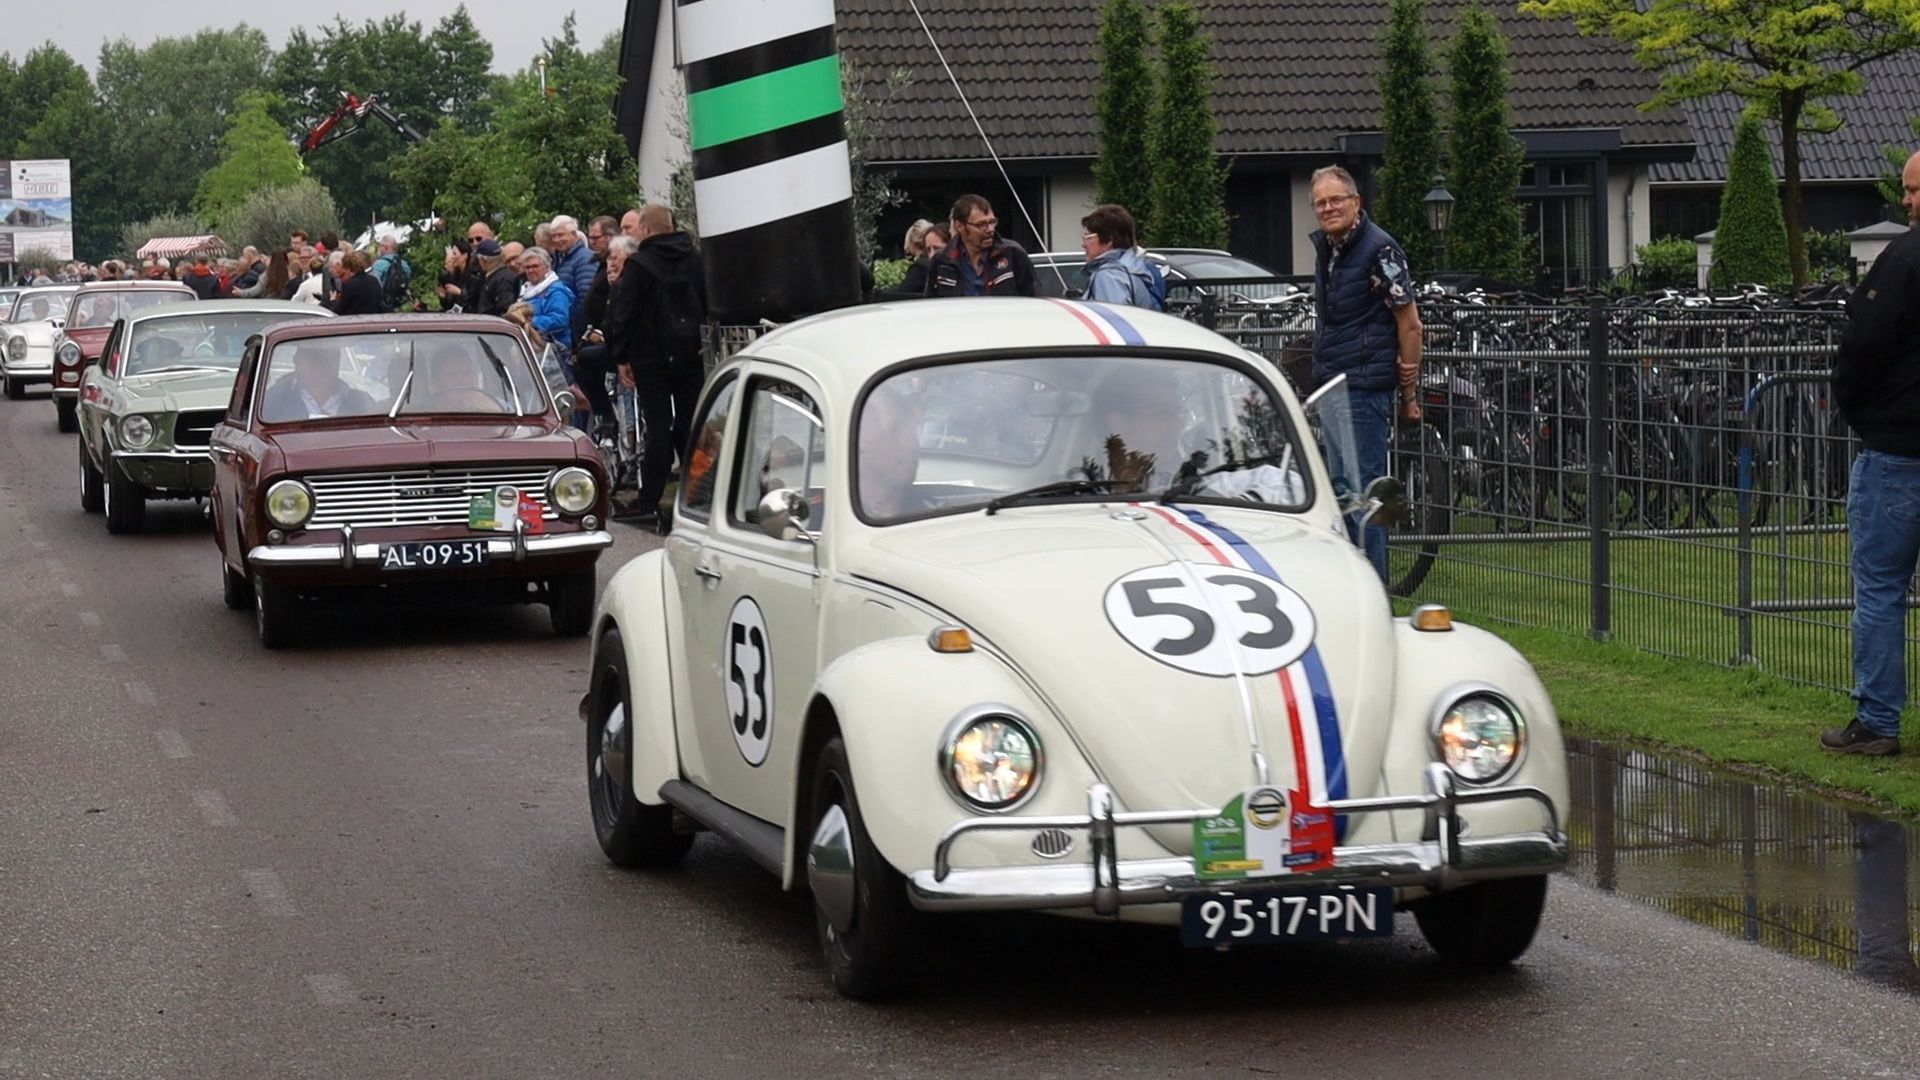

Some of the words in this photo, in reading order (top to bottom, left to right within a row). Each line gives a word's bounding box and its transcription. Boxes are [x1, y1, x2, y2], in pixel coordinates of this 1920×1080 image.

[384, 543, 483, 567] AL-09-51
[1121, 575, 1294, 656] 53
[731, 622, 767, 740] 53
[1200, 893, 1376, 939] 95-17-PN
